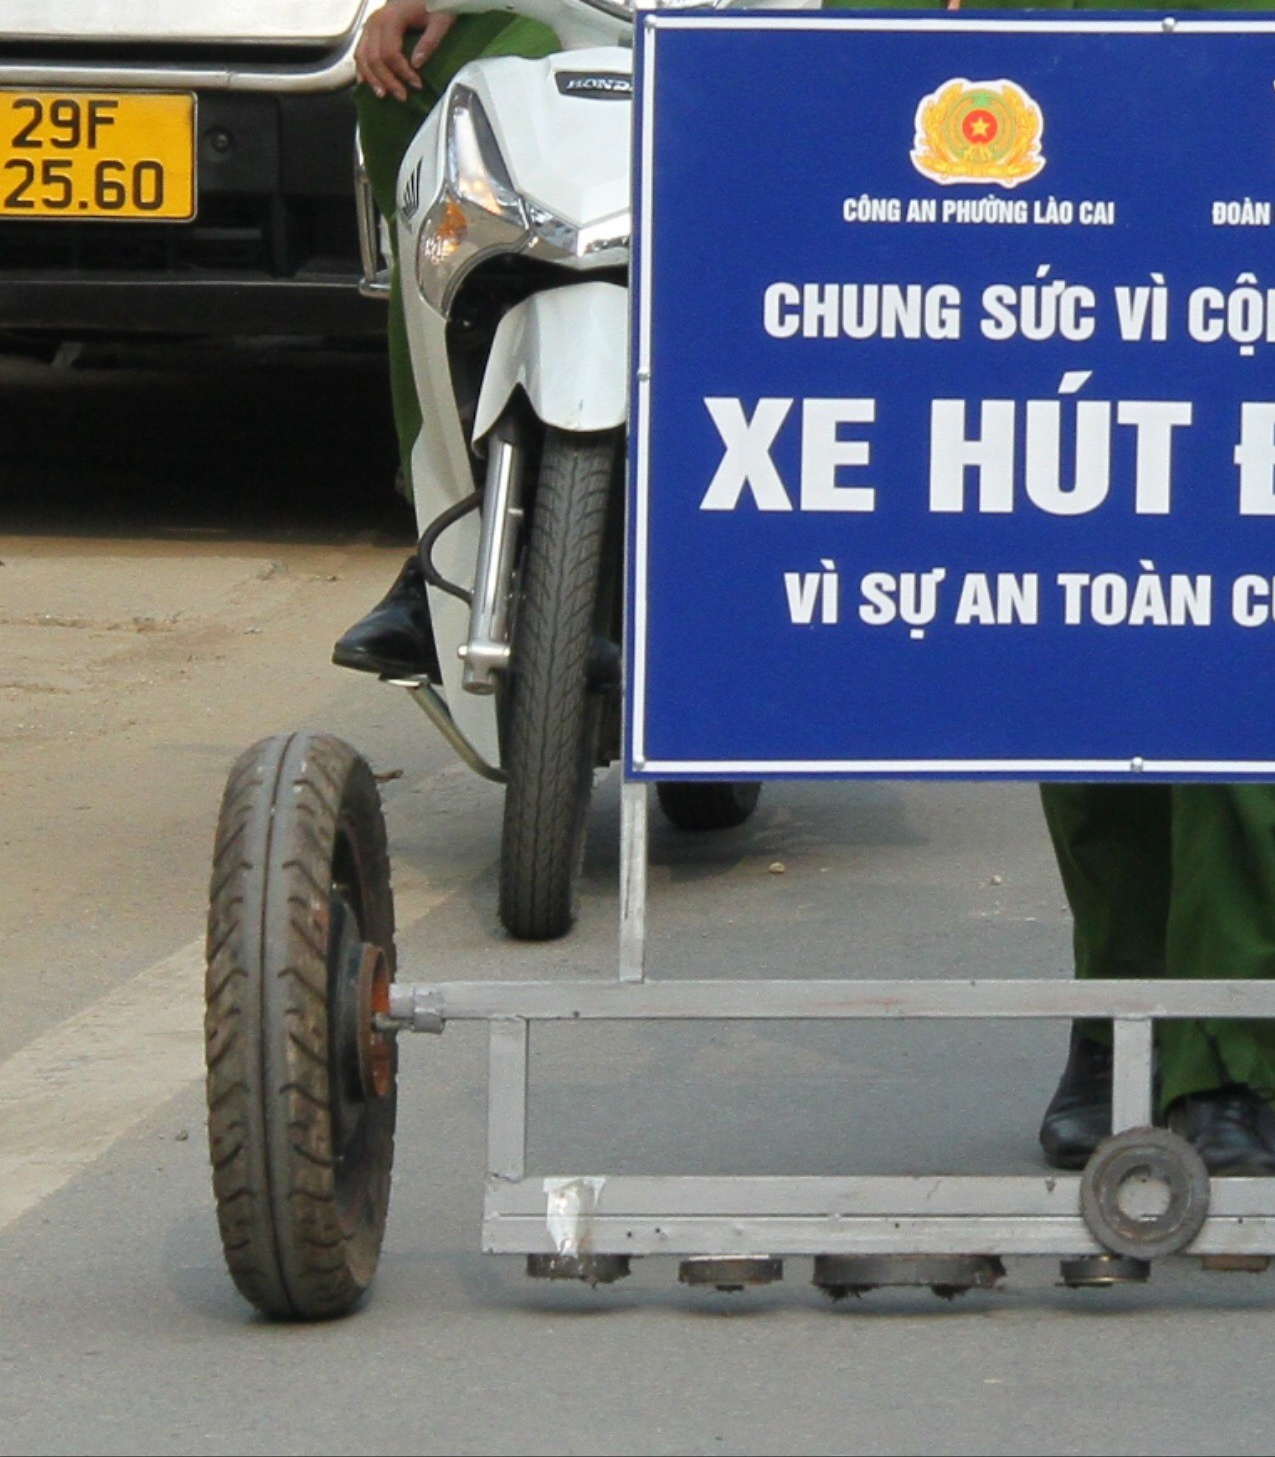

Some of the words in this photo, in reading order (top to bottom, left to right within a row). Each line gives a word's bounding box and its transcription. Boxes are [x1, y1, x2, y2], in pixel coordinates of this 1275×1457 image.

[566, 78, 633, 92] HOND
[11, 98, 119, 149] 29F
[3, 159, 164, 211] 25.60
[843, 194, 901, 222] CÔNG
[906, 199, 936, 222] AN
[942, 194, 1028, 224] PHƯỜNG
[1034, 196, 1073, 224] LÀO
[1079, 201, 1114, 225] CAI
[1212, 197, 1270, 225] ĐOÀN
[764, 282, 960, 339] CHUNG
[981, 264, 1095, 341] SỨC
[1115, 273, 1167, 341] VÌ
[700, 397, 875, 511] XE
[929, 371, 1192, 515] HÚT
[784, 559, 838, 624] VÌ
[859, 568, 946, 639] SỰ
[955, 573, 1038, 624] AN
[1057, 560, 1211, 626] TOÀN
